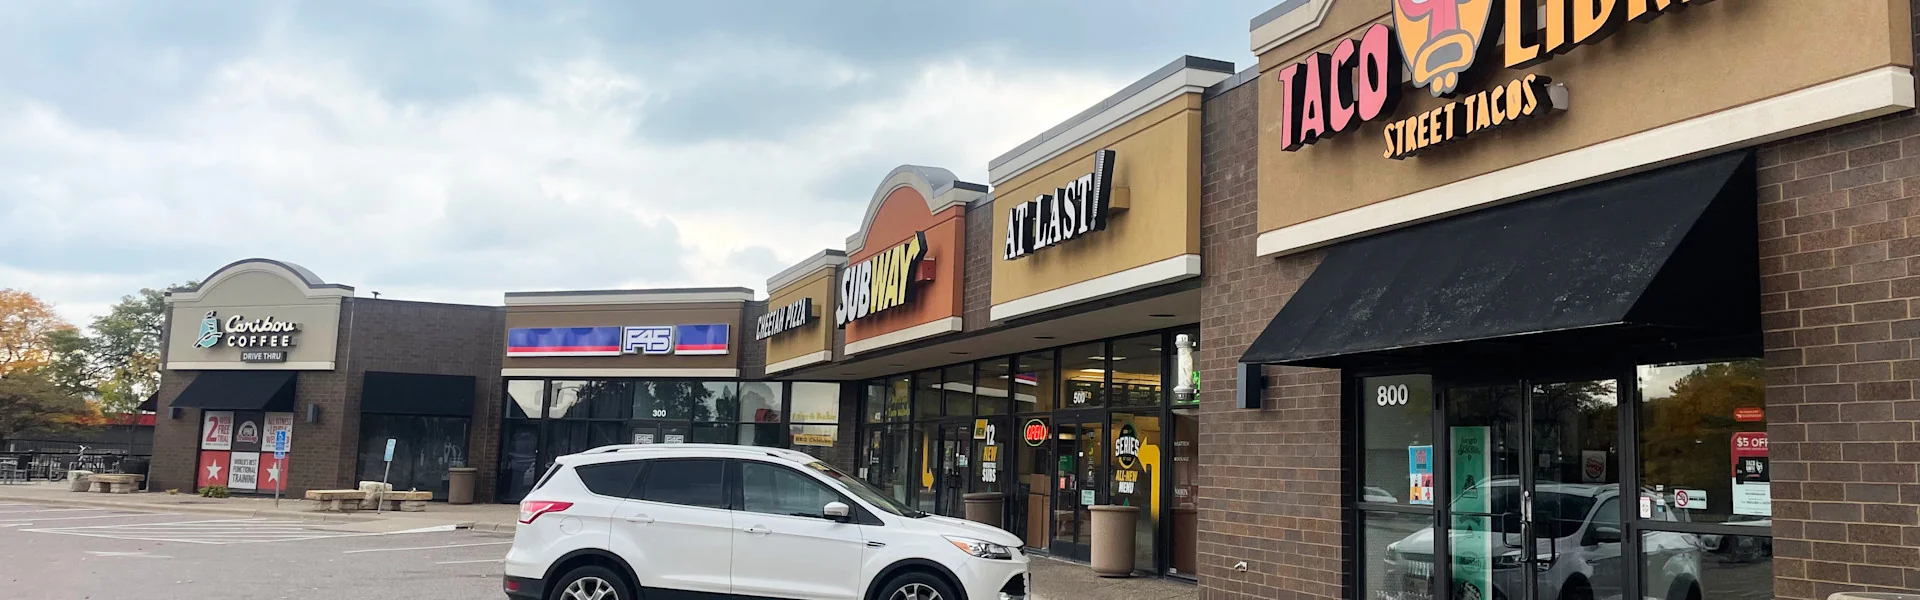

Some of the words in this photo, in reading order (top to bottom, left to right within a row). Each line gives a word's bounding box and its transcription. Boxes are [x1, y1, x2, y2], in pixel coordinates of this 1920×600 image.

[1279, 23, 1389, 151] TACO
[1382, 107, 1454, 159] STREET
[1464, 74, 1537, 130] TACOS
[1003, 201, 1029, 260] AT
[1033, 149, 1106, 251] LAST!
[835, 232, 921, 329] SUBWAY
[225, 314, 294, 333] Caribou
[756, 306, 786, 341] CHEETAH
[785, 298, 807, 330] PIZZA
[227, 335, 290, 347] COFFEE
[625, 329, 671, 352] F45
[242, 352, 262, 361] DRIVE
[263, 352, 282, 361] THRU
[1073, 391, 1086, 404] 500
[1376, 384, 1409, 407] 800
[652, 409, 667, 418] 300
[205, 416, 219, 442] 2
[218, 425, 230, 434] FREE
[986, 424, 995, 446] 12
[1026, 424, 1045, 441] OPEN
[217, 434, 229, 443] TRIAL
[1115, 436, 1140, 457] SERIES
[1736, 437, 1750, 448] $5
[983, 446, 998, 462] NEW
[232, 473, 256, 484] TRAINING
[982, 468, 997, 483] SUBS
[1115, 469, 1139, 483] ALL-NEW
[1118, 481, 1135, 494] MENU
